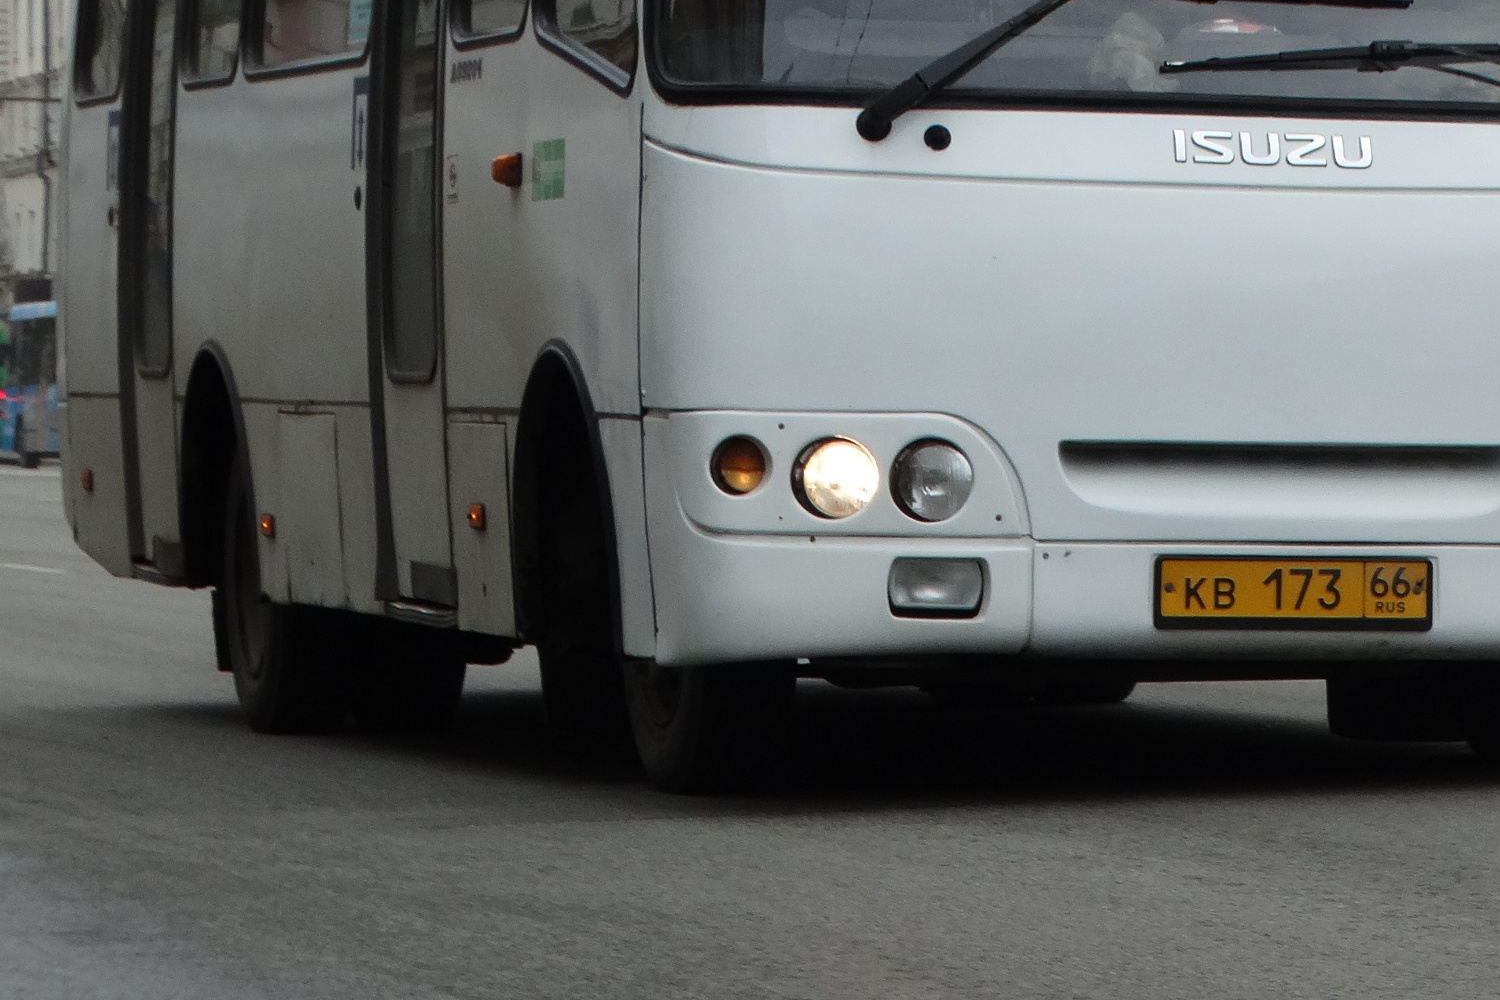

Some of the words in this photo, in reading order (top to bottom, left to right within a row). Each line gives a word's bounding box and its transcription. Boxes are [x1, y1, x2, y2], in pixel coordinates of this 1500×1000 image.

[1172, 128, 1374, 169] ISUZU
[1262, 567, 1343, 611] 173
[1369, 565, 1411, 599] 66
[1374, 601, 1407, 613] RUS
